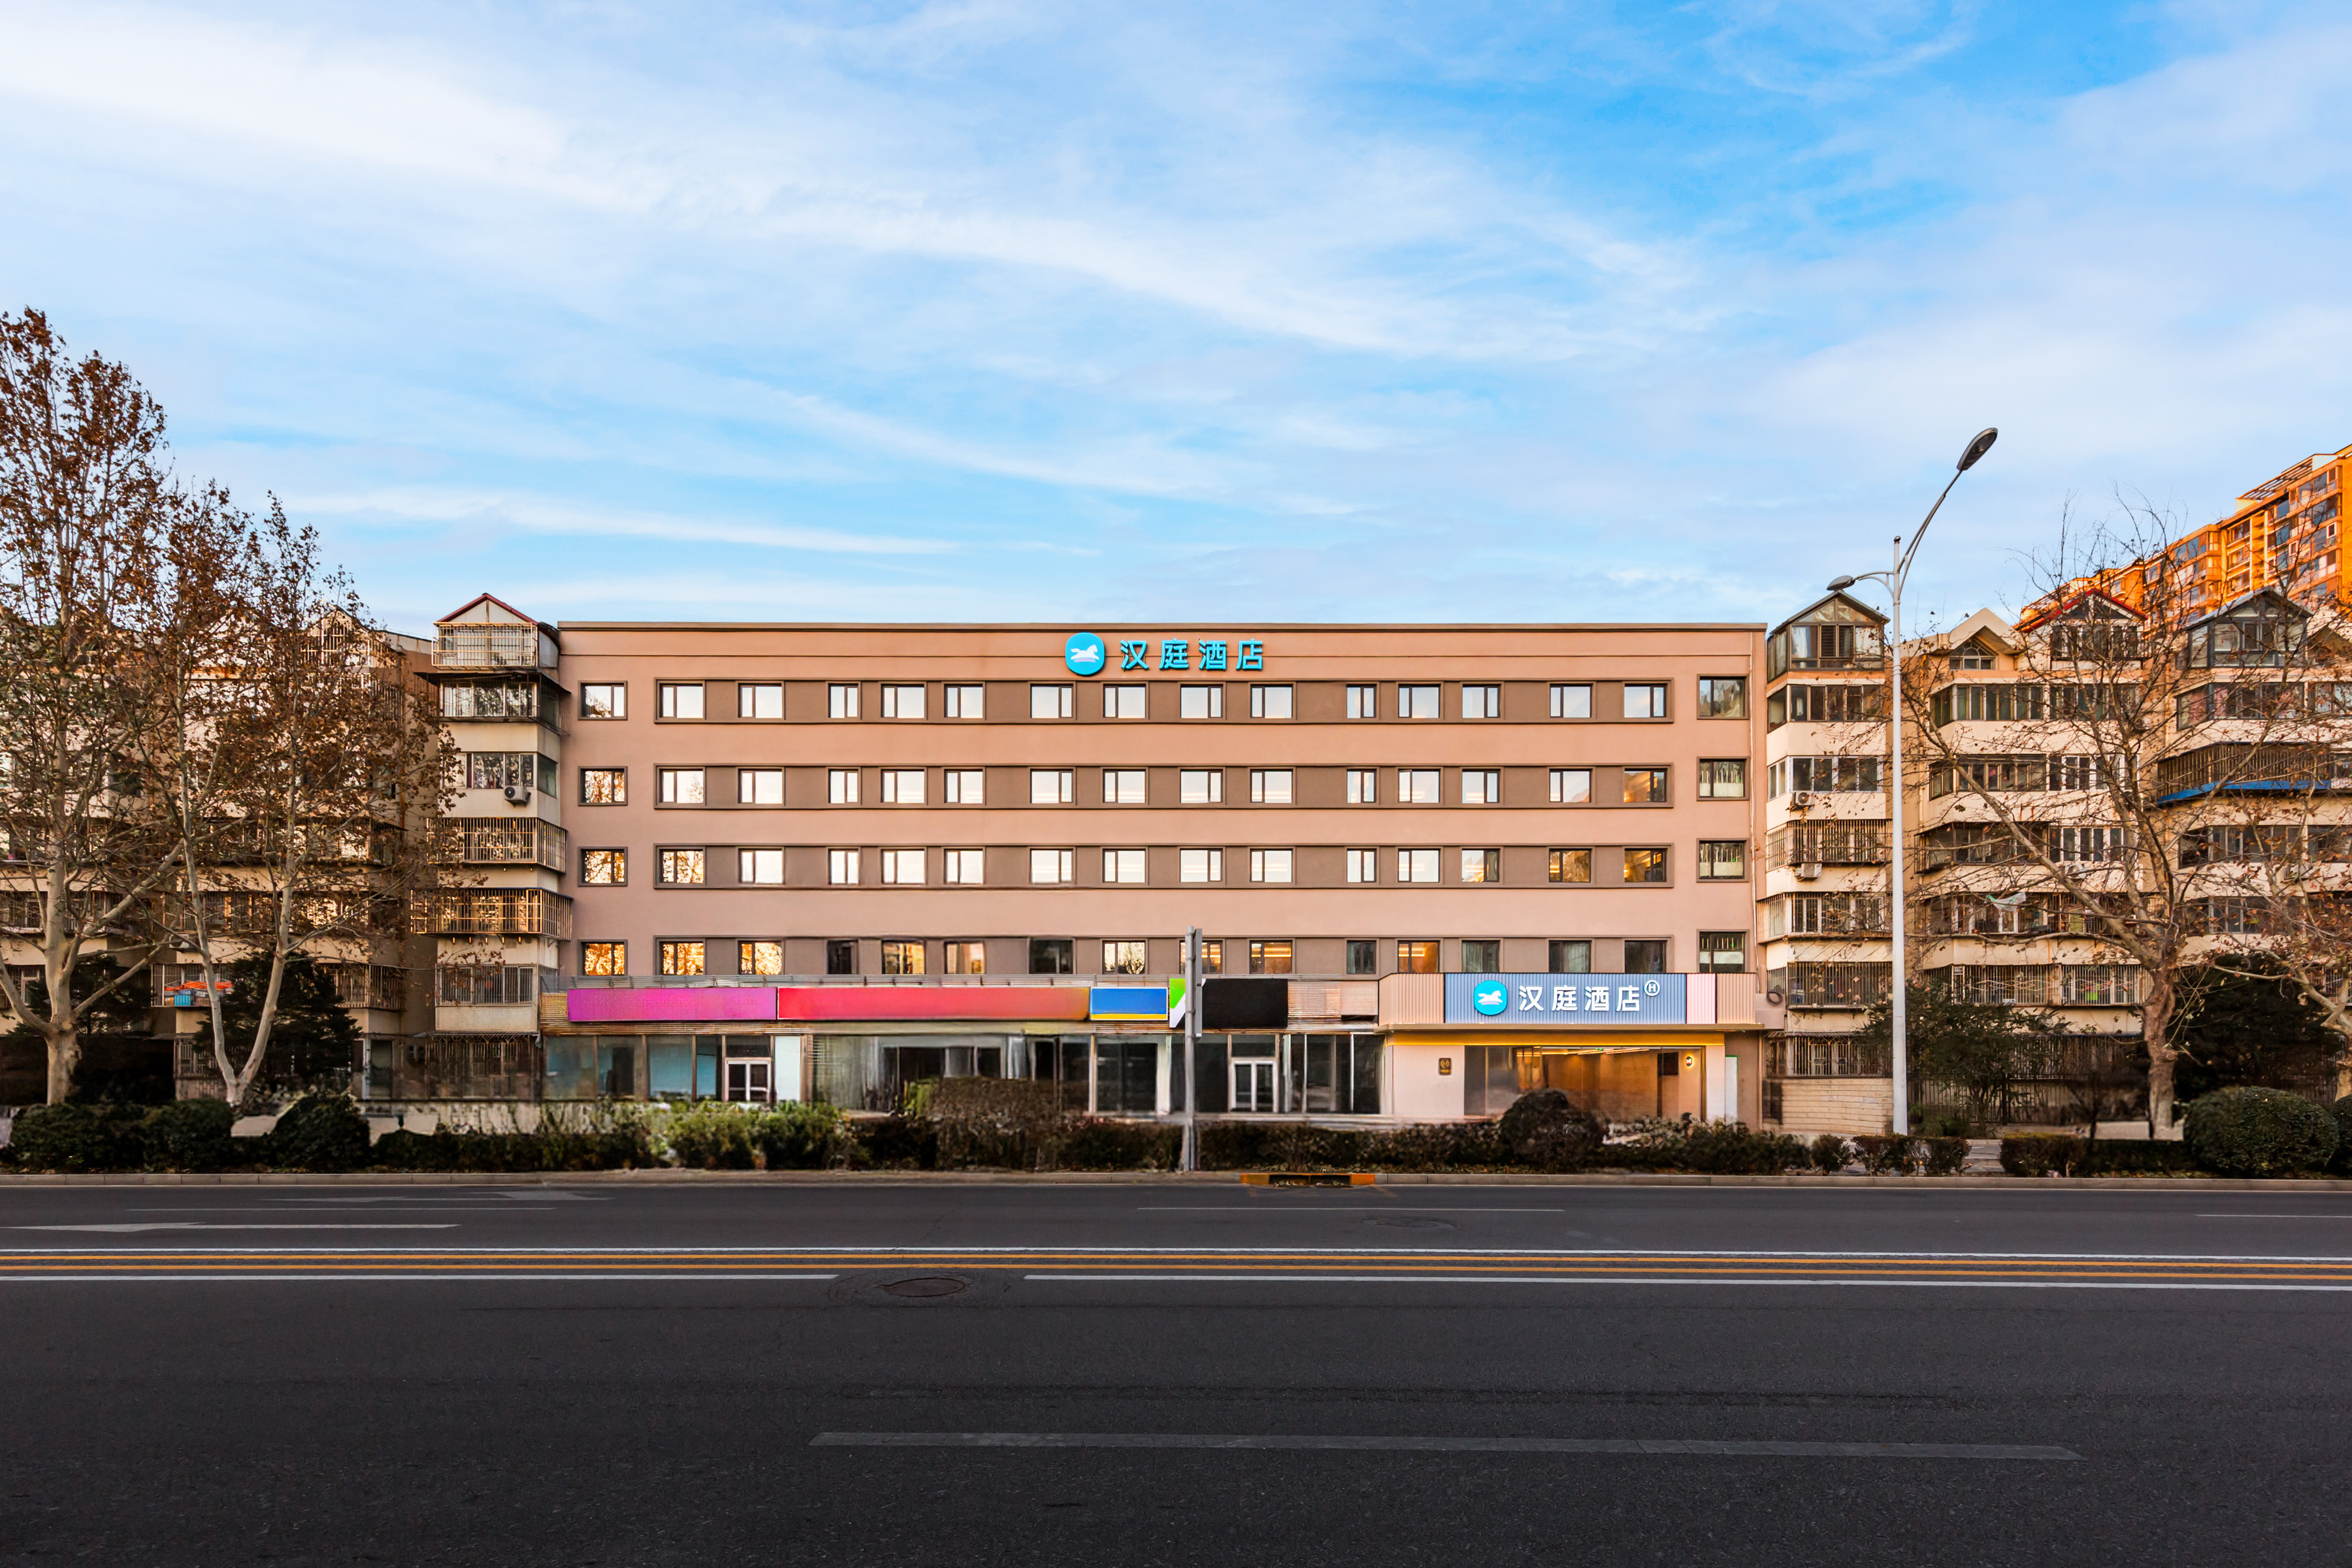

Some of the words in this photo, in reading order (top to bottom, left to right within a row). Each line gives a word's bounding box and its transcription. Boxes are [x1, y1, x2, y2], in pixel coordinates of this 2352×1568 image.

[1120, 638, 1262, 669] 汉庭酒店
[1519, 985, 1641, 1011] 汉庭酒店
